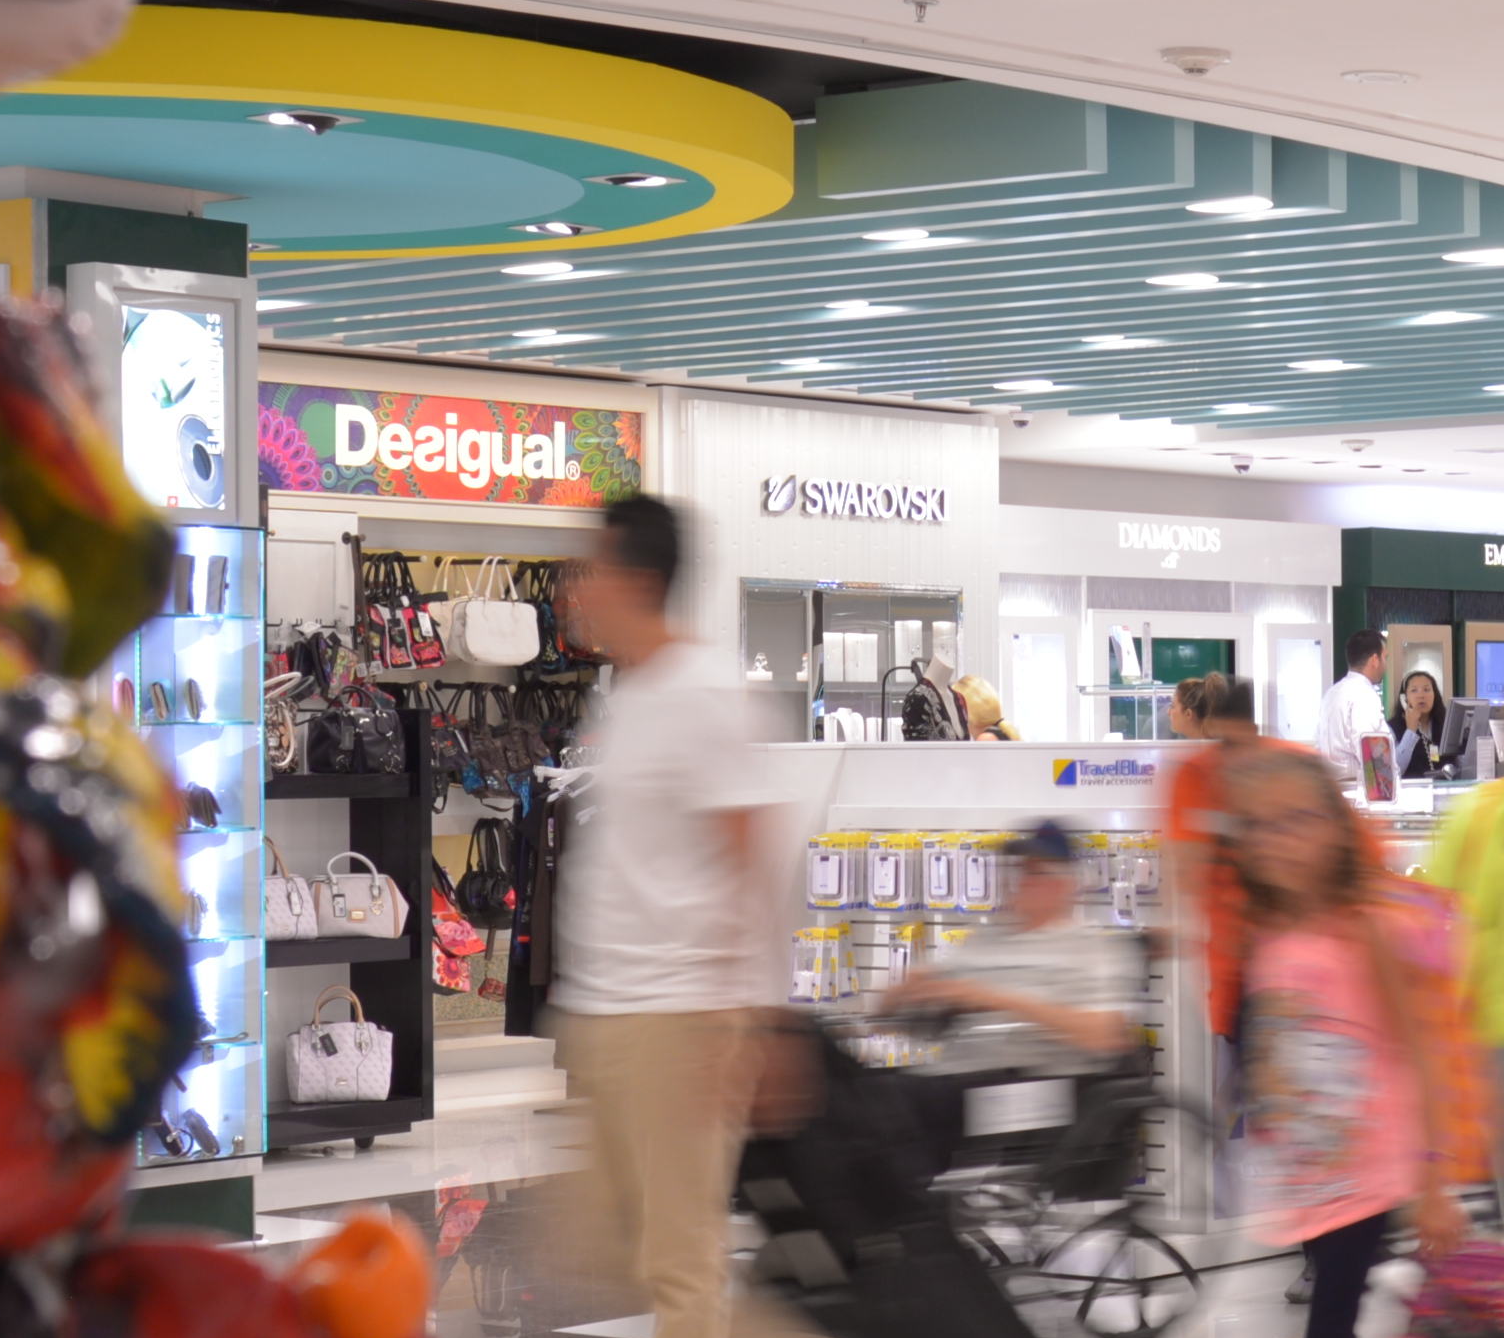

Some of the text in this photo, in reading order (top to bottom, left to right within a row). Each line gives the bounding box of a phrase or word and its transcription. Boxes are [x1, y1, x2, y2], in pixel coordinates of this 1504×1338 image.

[335, 403, 566, 489] Desigual
[802, 477, 951, 523] SWAROVSKI
[1118, 522, 1221, 552] DIAMONDS
[1080, 777, 1153, 786] travel accessories
